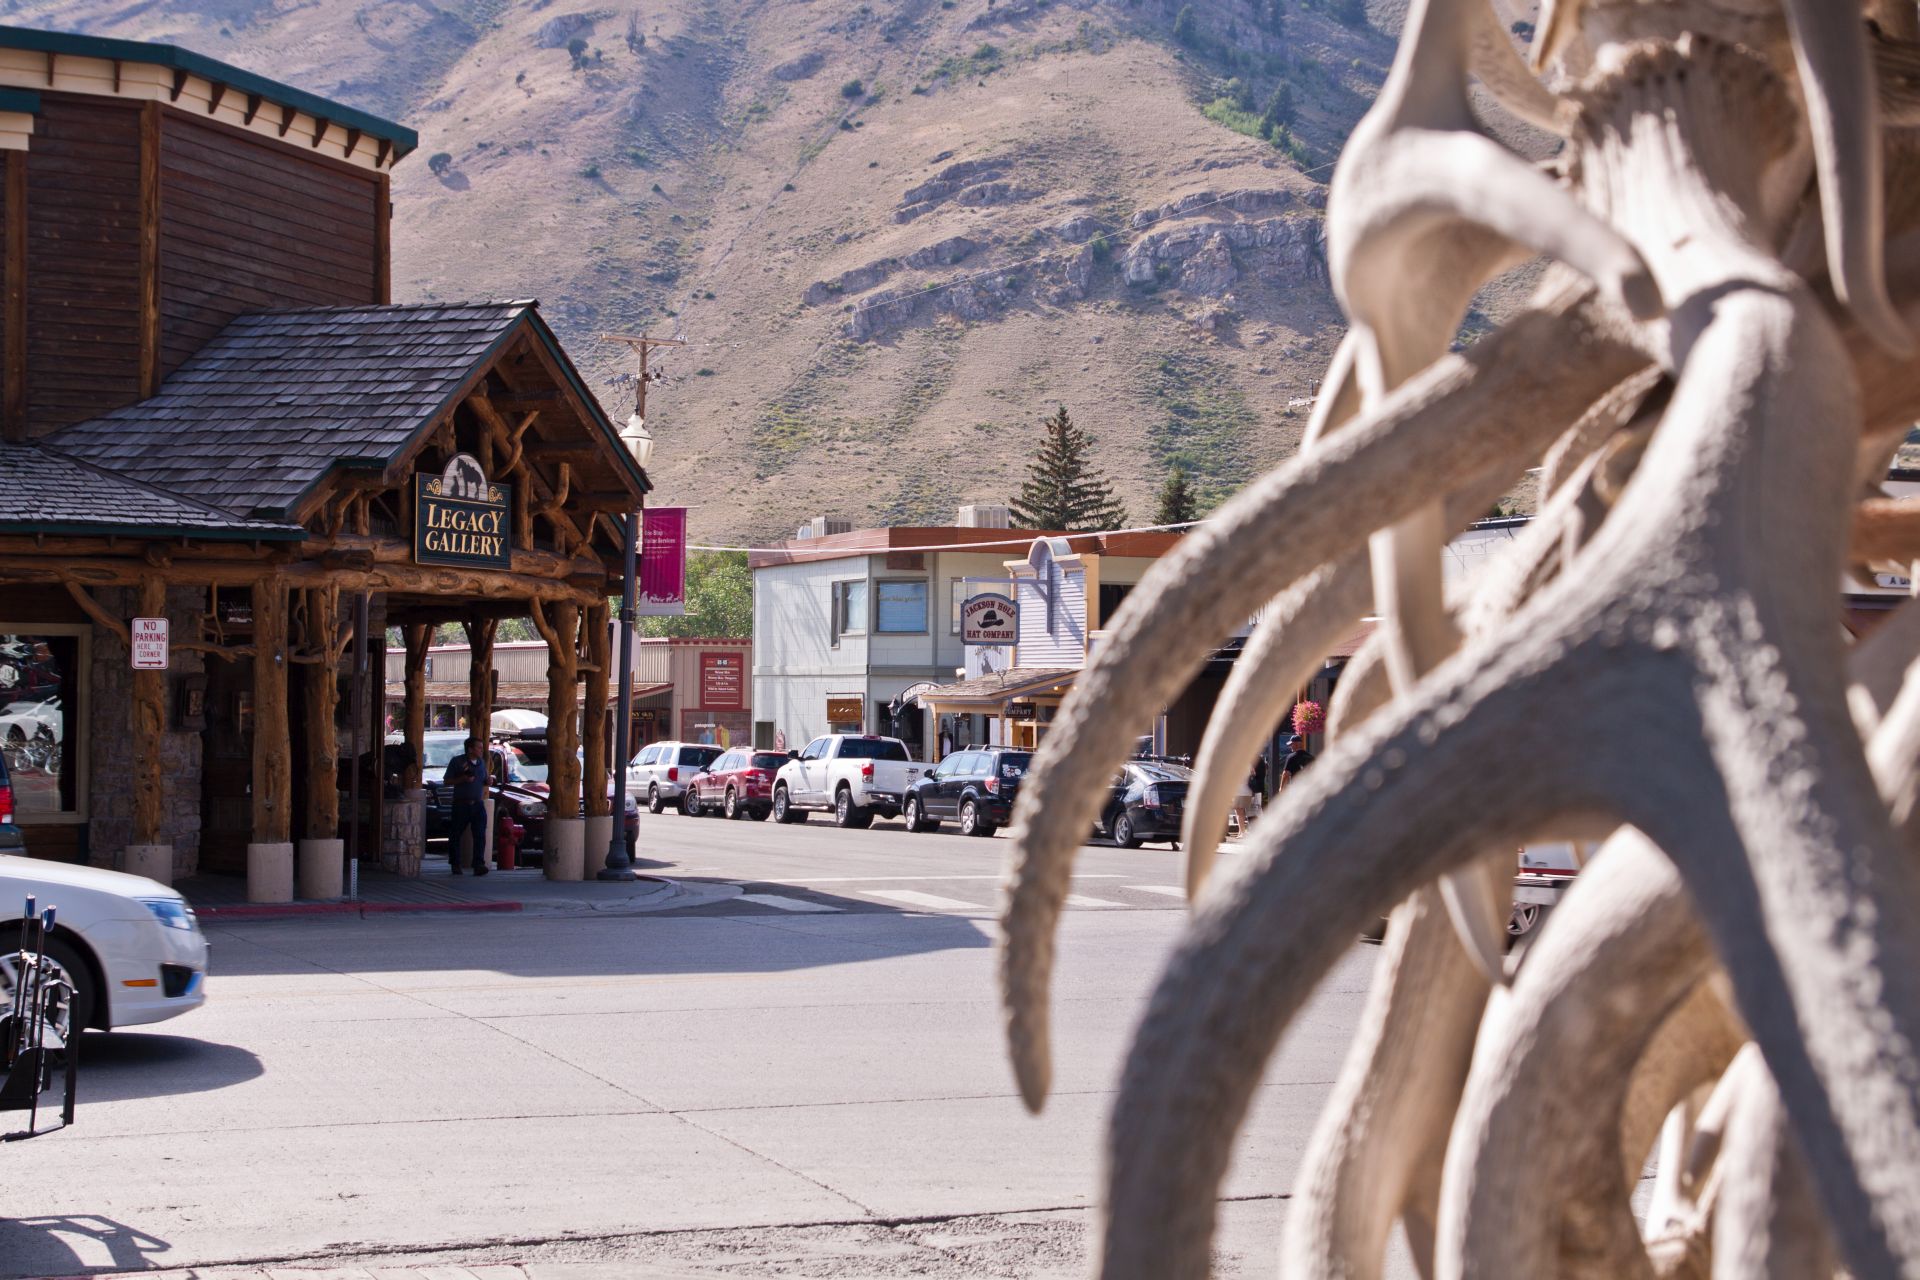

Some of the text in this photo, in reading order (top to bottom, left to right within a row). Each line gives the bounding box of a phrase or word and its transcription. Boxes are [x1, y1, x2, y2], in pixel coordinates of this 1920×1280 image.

[427, 503, 505, 534] LEGACY
[425, 530, 504, 556] GALLERY
[966, 600, 1016, 618] JACKSON HOLE
[143, 621, 157, 631] NO
[135, 632, 166, 642] PARKING
[967, 630, 1015, 639] HAT COMPANY
[139, 650, 161, 658] CORNER
